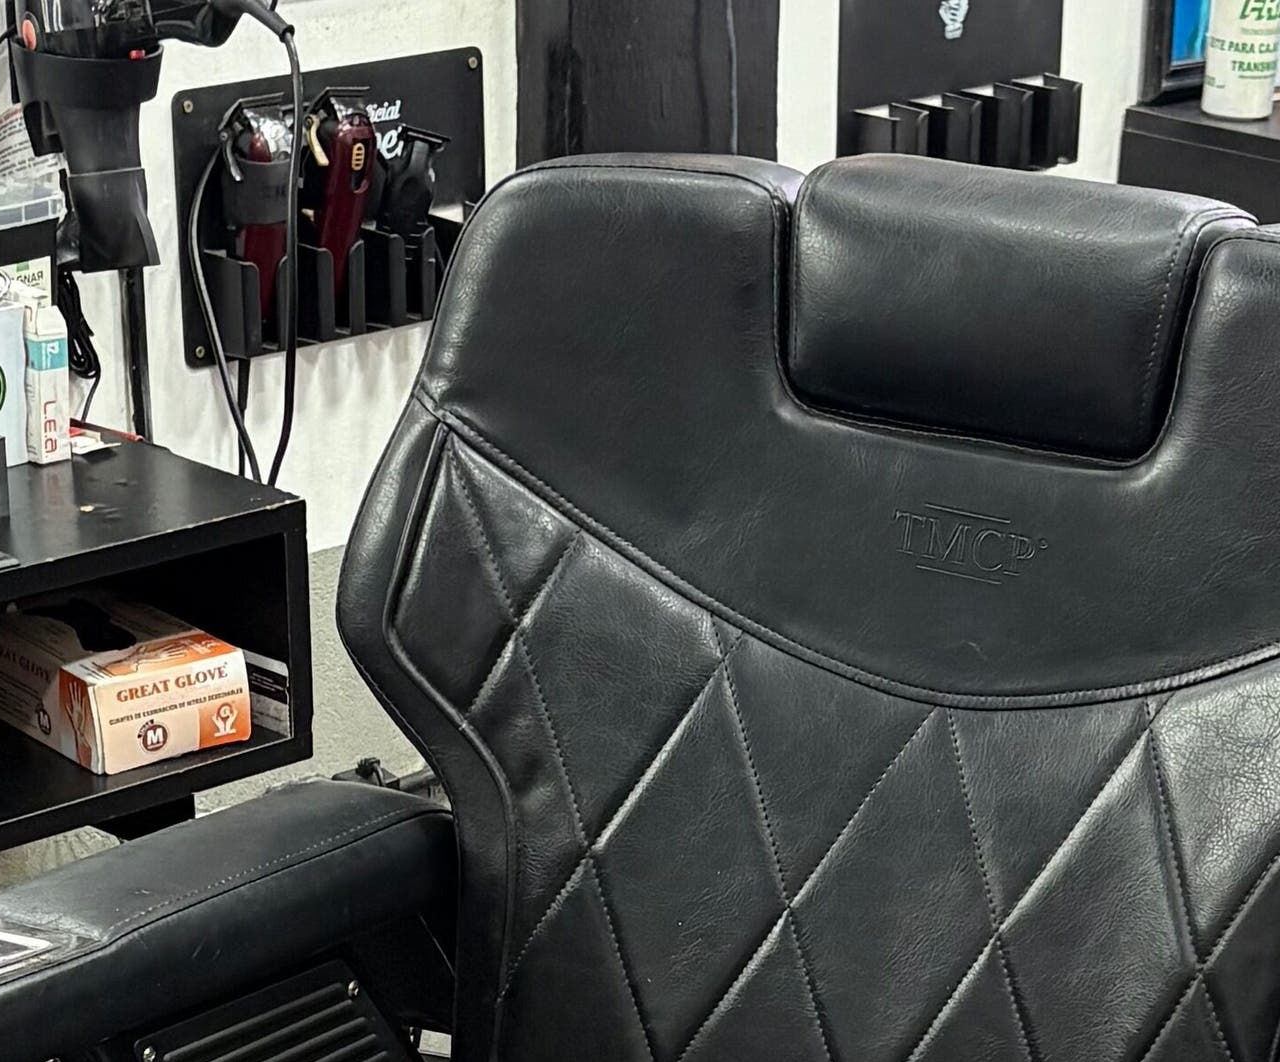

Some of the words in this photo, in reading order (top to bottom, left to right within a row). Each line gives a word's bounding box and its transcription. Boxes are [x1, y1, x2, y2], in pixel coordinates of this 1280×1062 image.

[1228, 41, 1255, 54] PARA
[116, 680, 171, 702] GREAT
[175, 665, 228, 689] GLOVE
